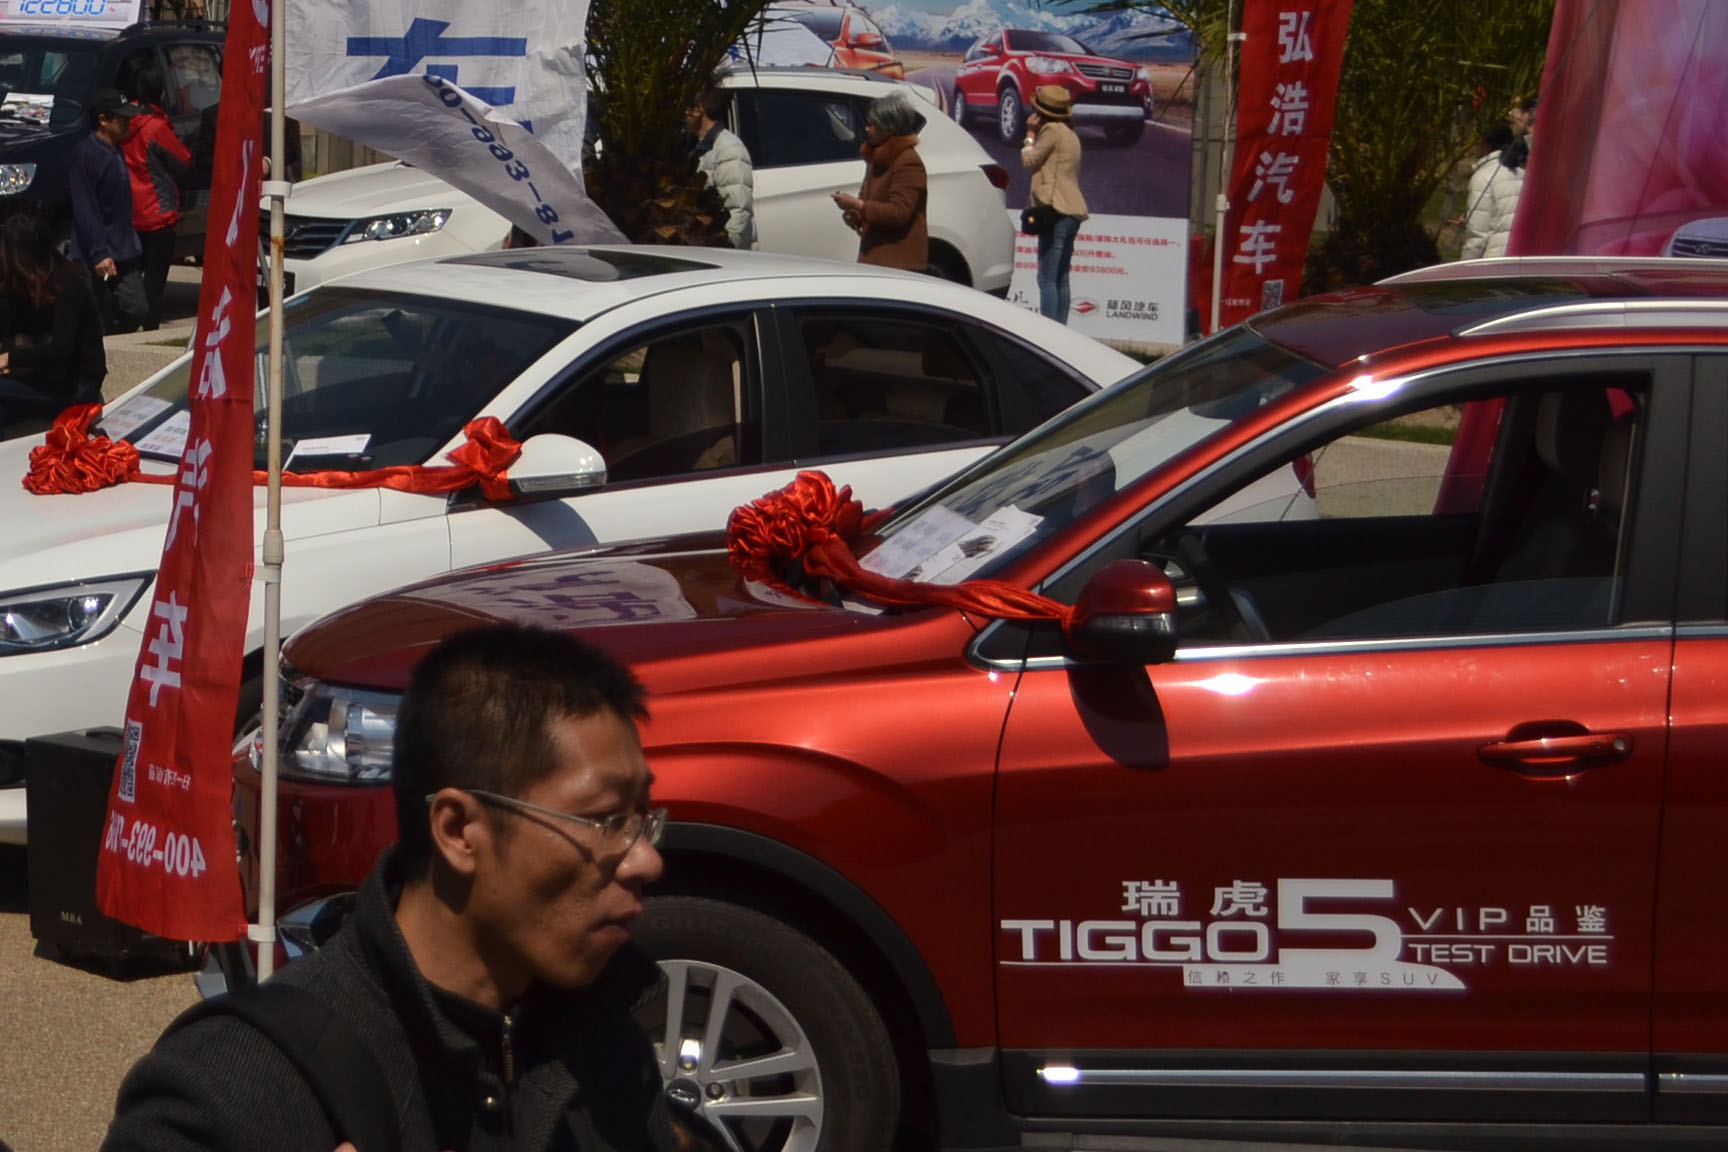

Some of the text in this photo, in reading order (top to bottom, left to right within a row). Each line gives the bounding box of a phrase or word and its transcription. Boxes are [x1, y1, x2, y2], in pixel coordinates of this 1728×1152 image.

[1233, 11, 1313, 274] 弘浩汽车
[1106, 299, 1159, 312] 陆风汽车
[1106, 310, 1159, 321] LANDWIND
[1121, 879, 1270, 917] 瑞虎
[1000, 878, 1403, 963] TIGGO 5
[1407, 904, 1607, 933] VIP 品鉴
[1408, 943, 1608, 964] TEST DRIVE
